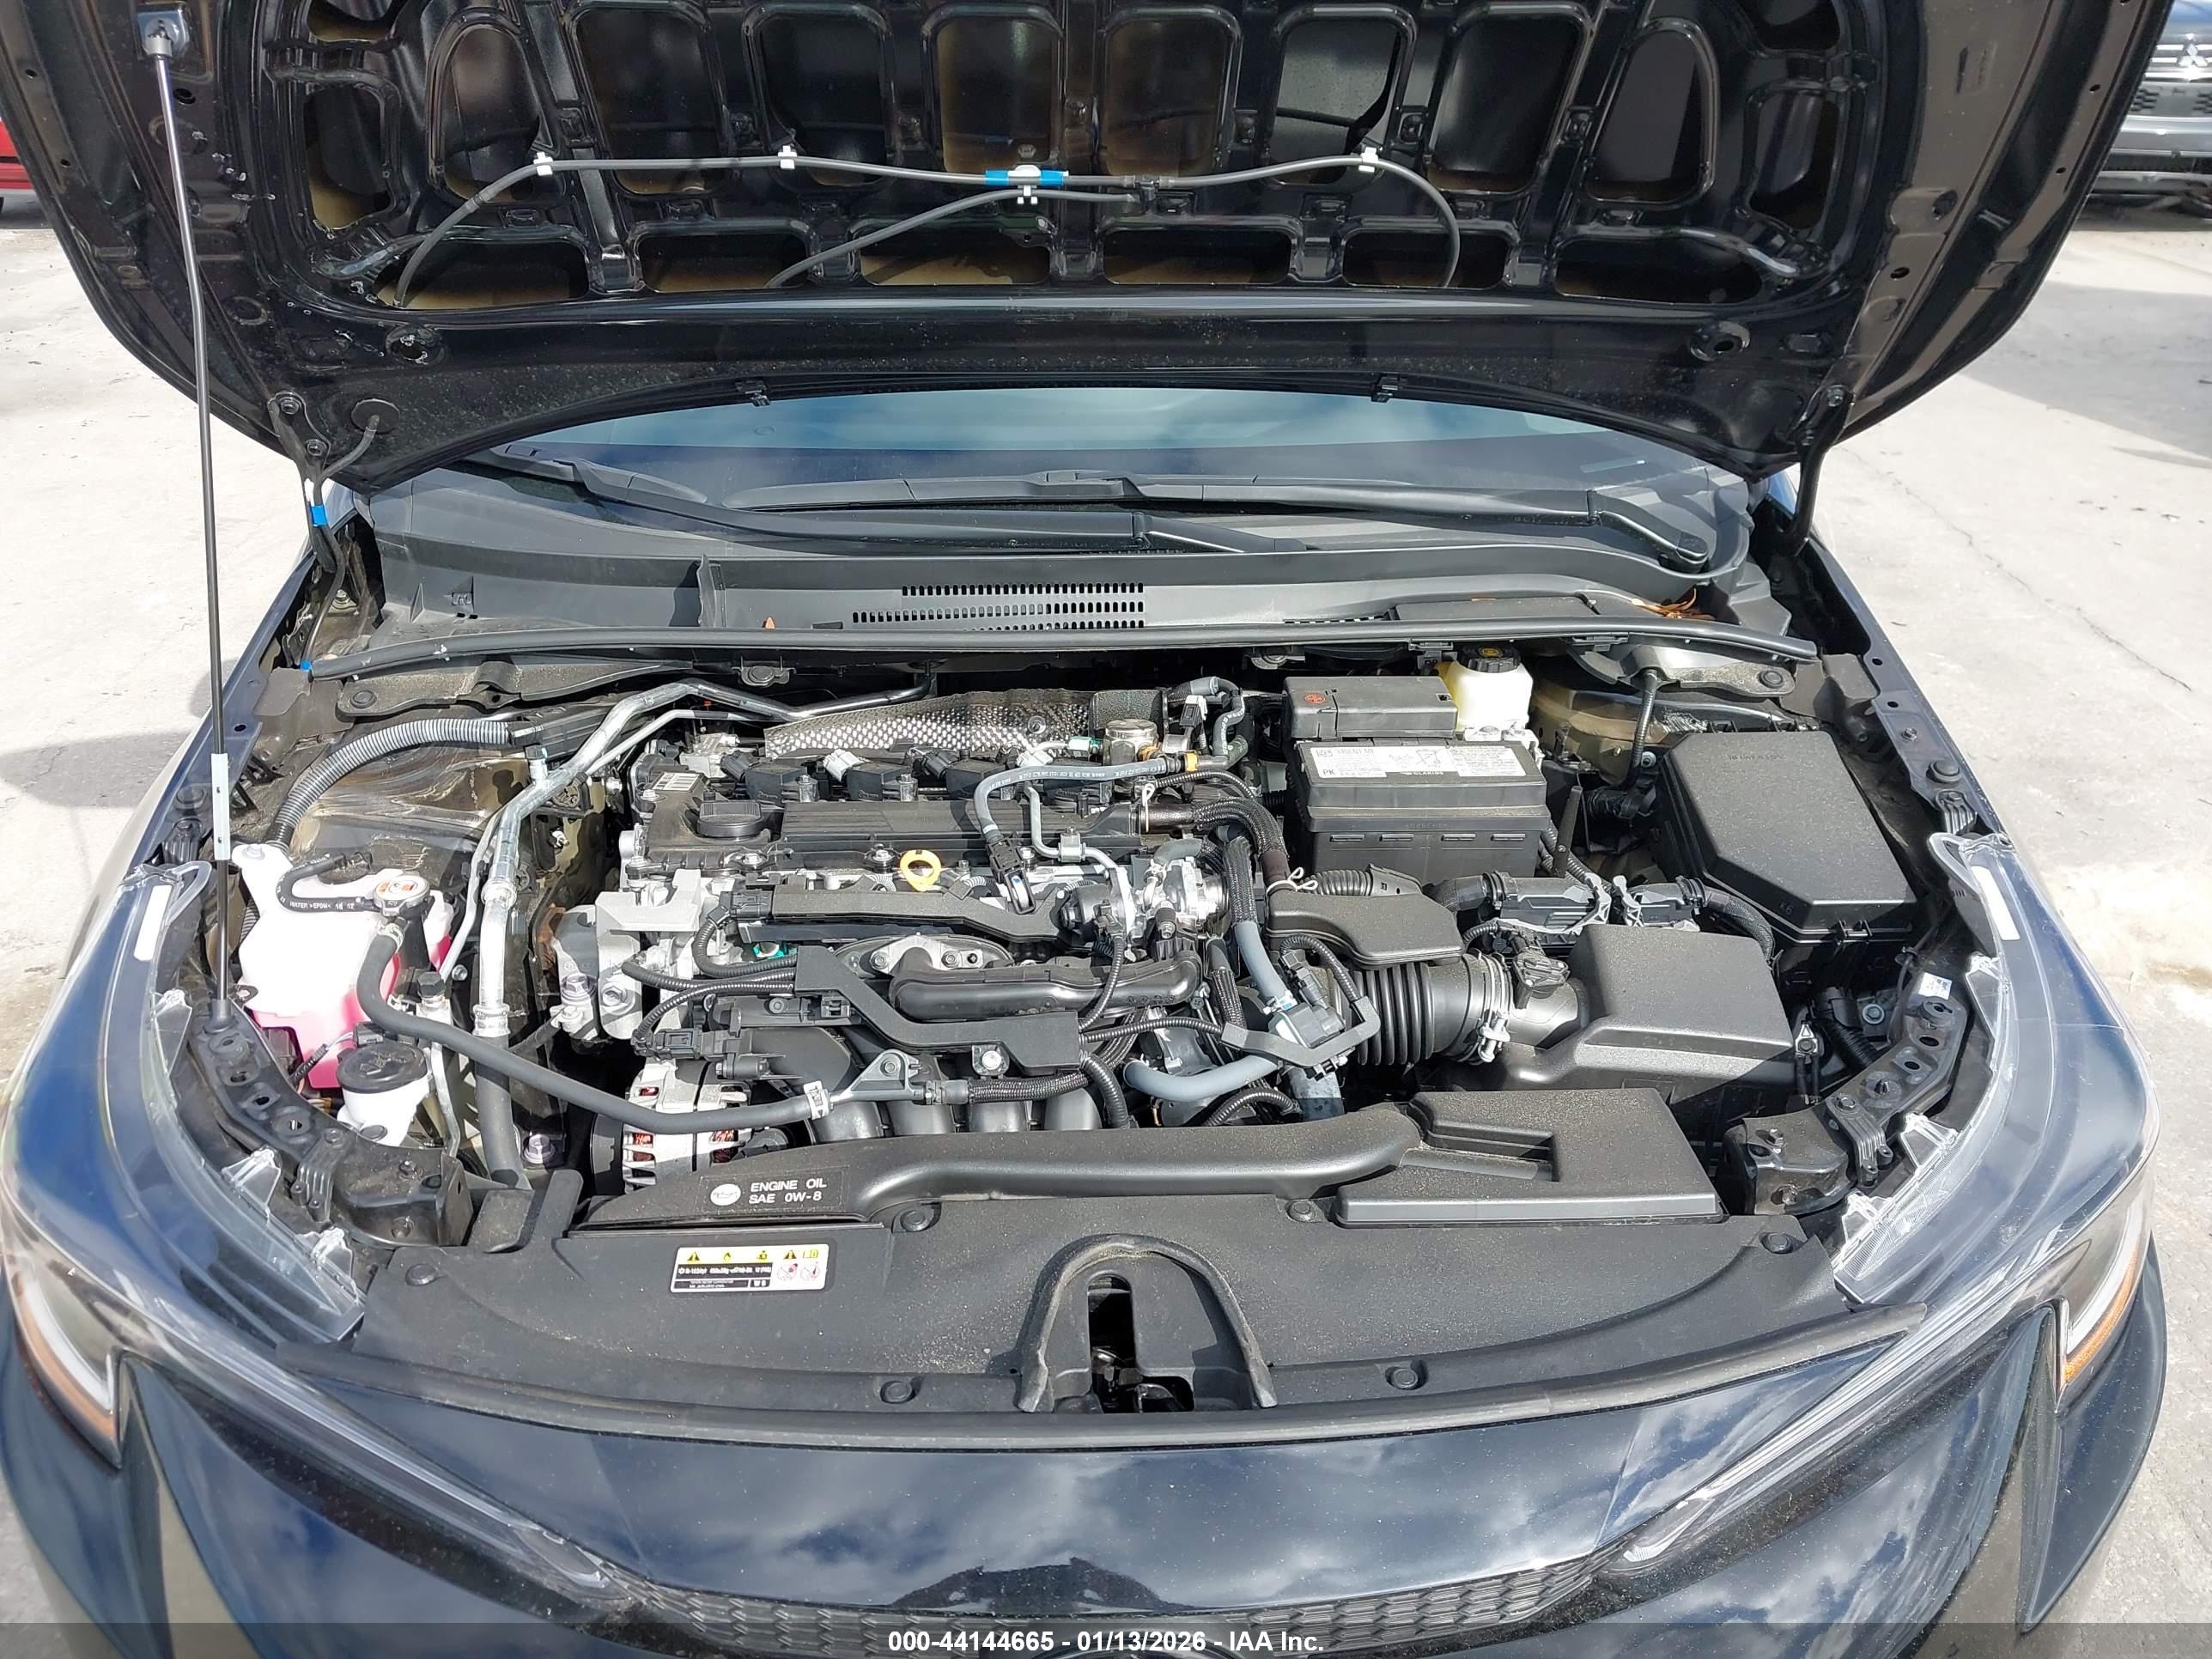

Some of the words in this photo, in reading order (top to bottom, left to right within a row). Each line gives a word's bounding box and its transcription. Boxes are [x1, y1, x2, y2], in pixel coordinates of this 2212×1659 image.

[750, 1179, 799, 1193] ENGINE
[805, 1177, 828, 1189] OIL
[748, 1193, 775, 1205] SAE
[784, 1190, 823, 1203] 0W-8
